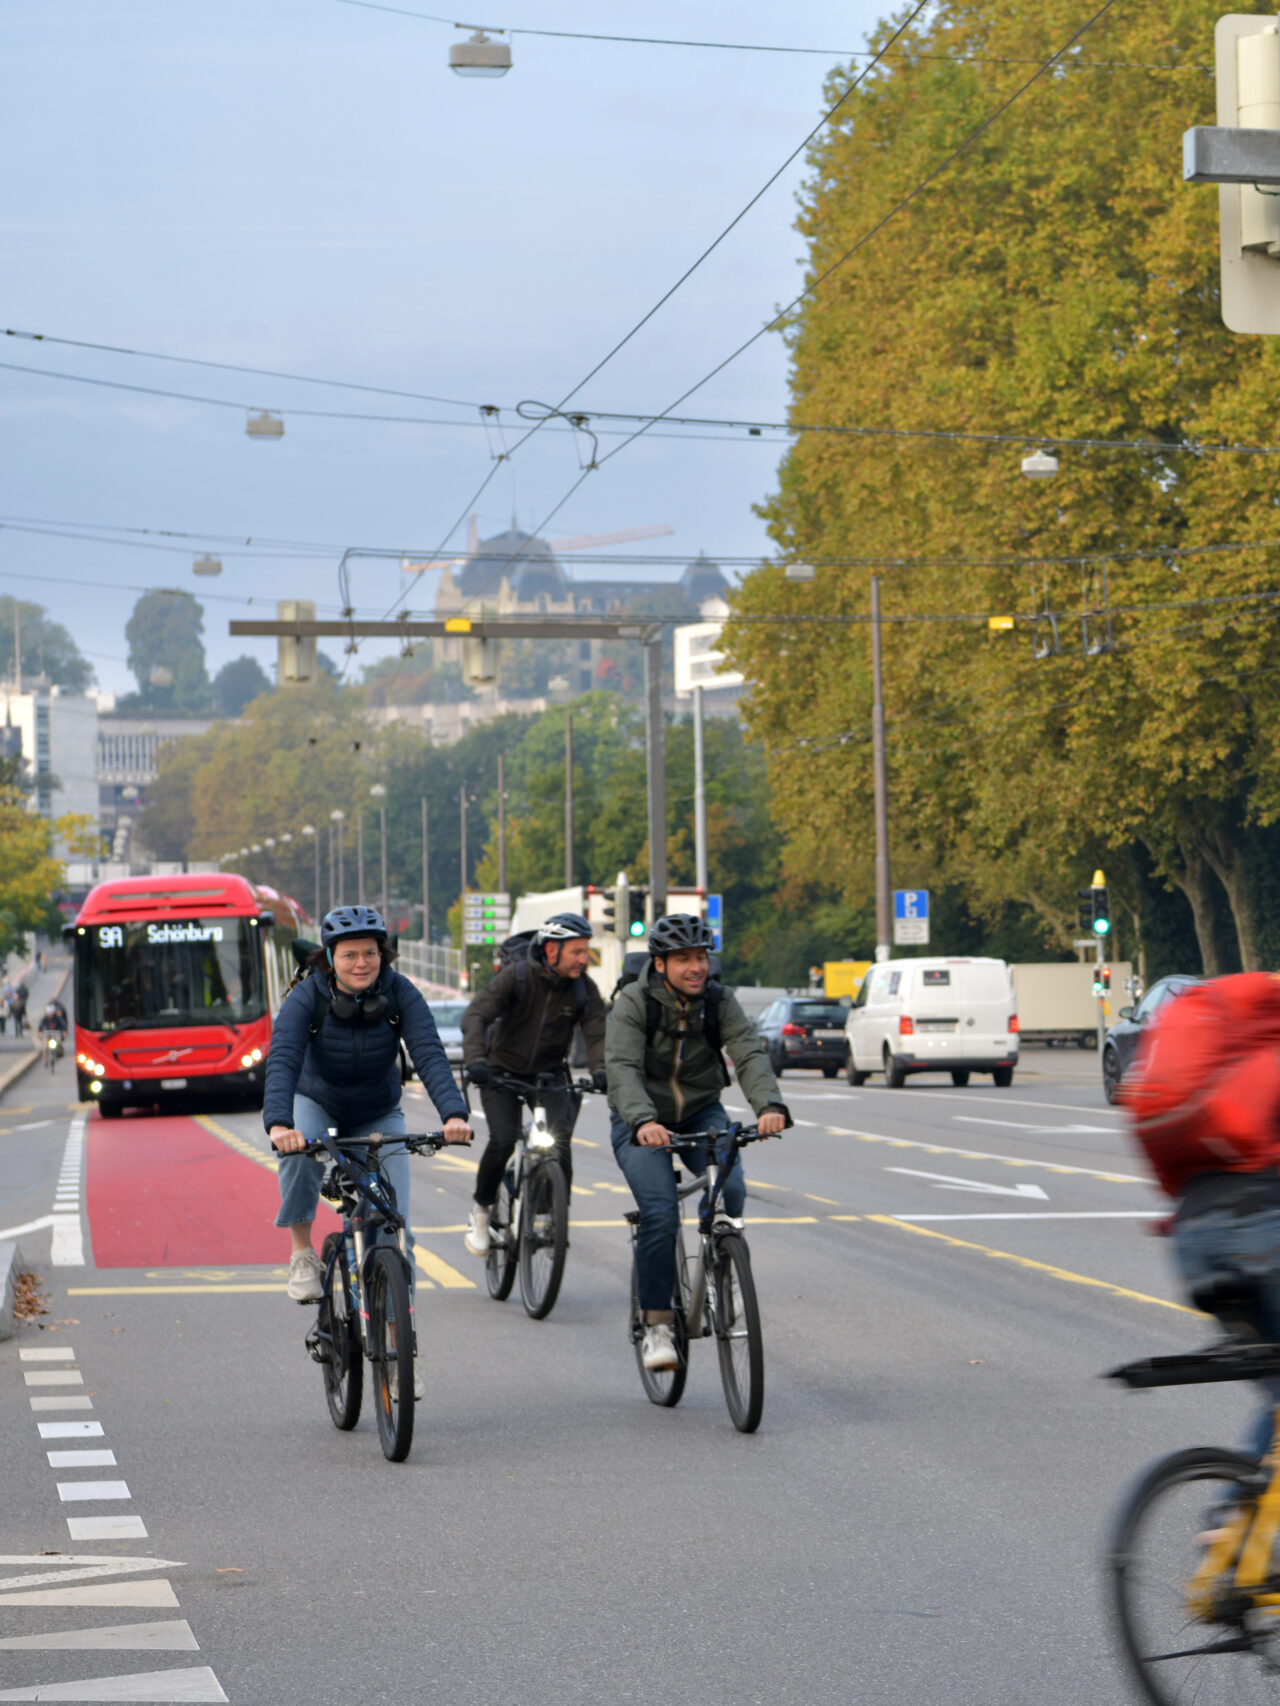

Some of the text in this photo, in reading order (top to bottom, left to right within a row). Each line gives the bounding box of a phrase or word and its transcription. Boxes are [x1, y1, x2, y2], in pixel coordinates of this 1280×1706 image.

[904, 892, 918, 907] P
[99, 922, 224, 948] 9A Schönburg
